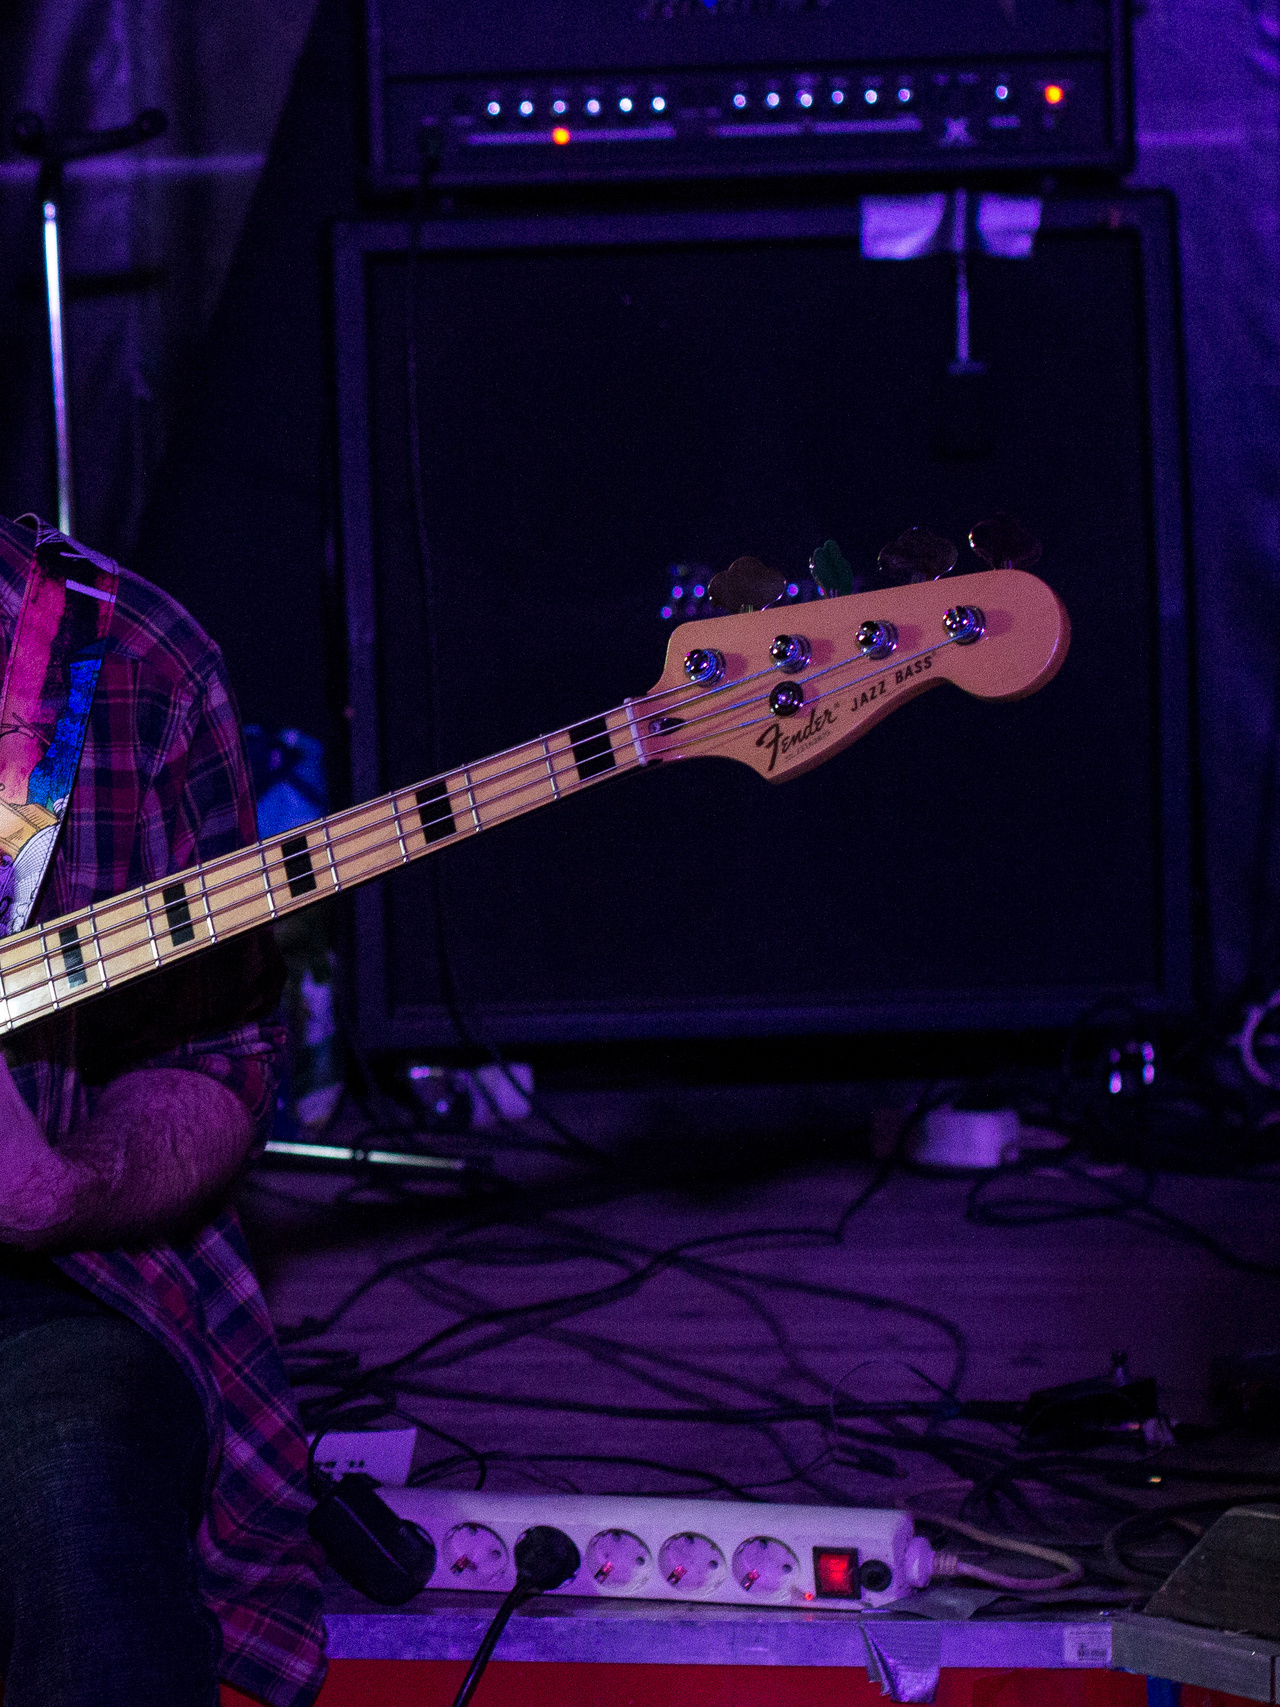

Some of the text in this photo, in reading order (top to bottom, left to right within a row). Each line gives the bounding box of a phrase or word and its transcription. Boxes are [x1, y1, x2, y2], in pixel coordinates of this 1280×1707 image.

[756, 708, 838, 772] Fender
[851, 681, 886, 712] JAZZ
[895, 656, 933, 684] BASS
